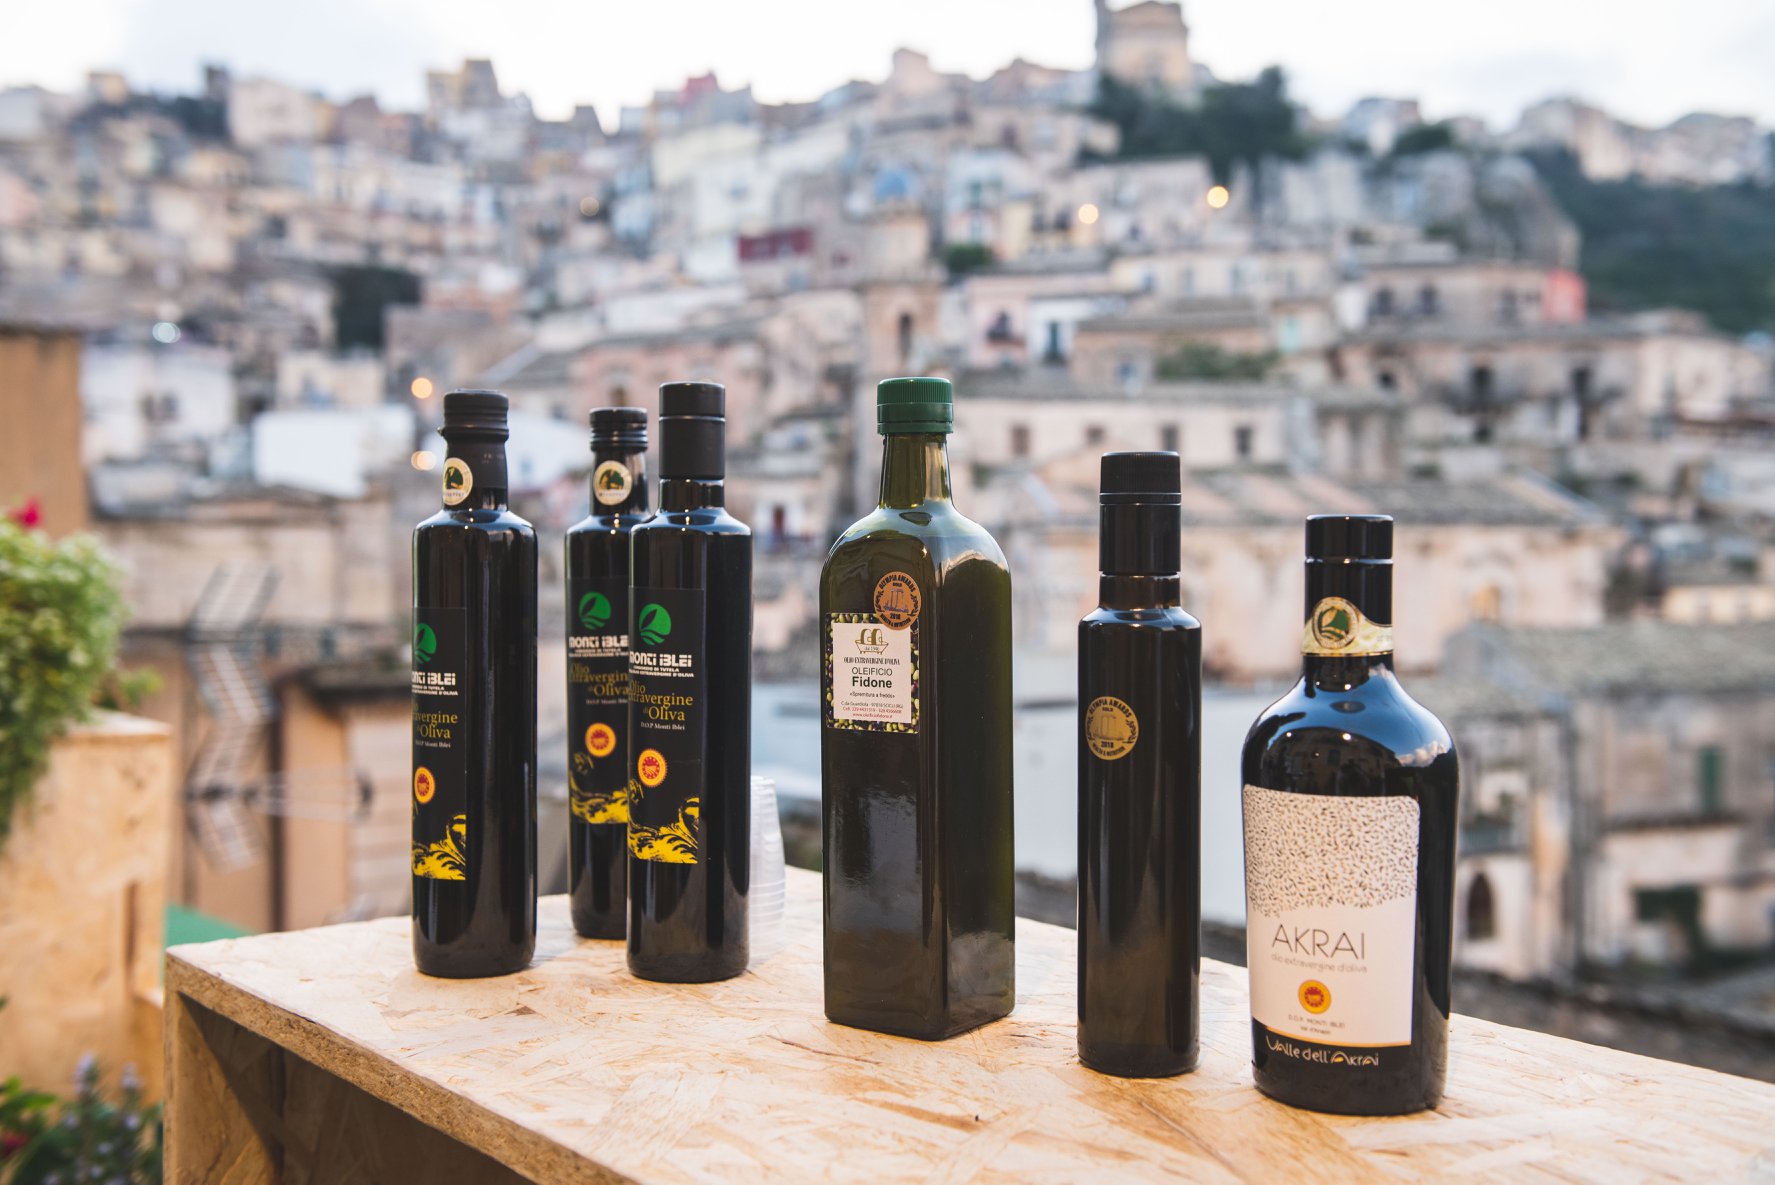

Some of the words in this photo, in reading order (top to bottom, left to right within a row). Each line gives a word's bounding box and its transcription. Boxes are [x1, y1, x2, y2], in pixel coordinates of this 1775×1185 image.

[851, 666, 893, 676] OLEIFICIO
[852, 676, 893, 688] Fidone
[648, 706, 685, 721] Oliva
[1272, 923, 1365, 960] AKRAI
